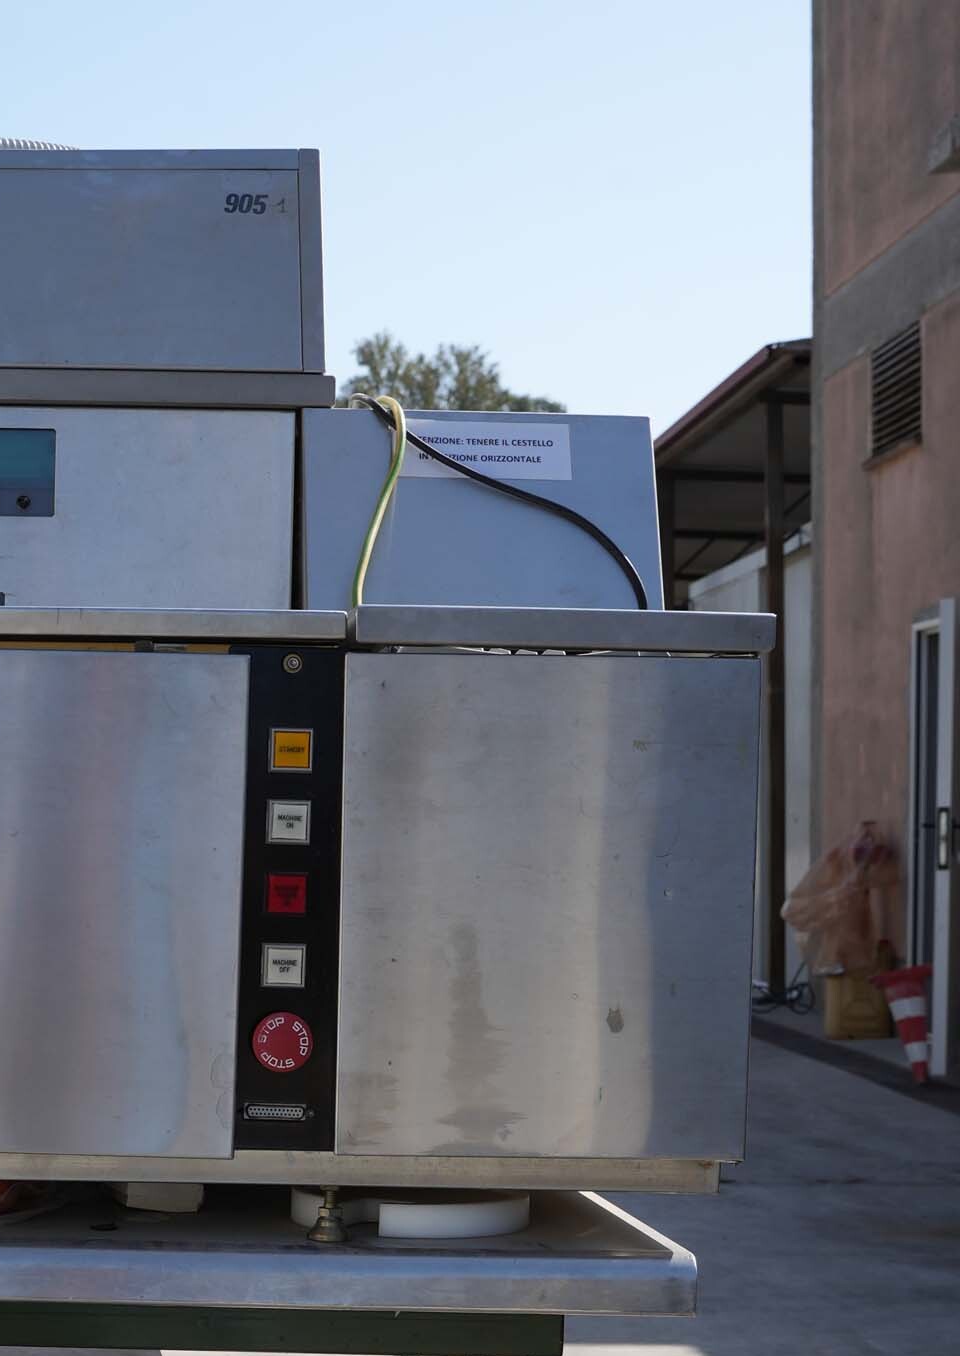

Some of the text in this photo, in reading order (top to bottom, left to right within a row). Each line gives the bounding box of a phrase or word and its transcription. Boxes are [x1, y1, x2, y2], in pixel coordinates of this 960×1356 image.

[224, 193, 268, 214] 905
[467, 438, 500, 446] TENERE
[419, 452, 429, 460] IN
[480, 454, 542, 463] ORIZZONTALE
[258, 1017, 284, 1043] STOP
[292, 1021, 309, 1056] STOP
[260, 1052, 295, 1069] STOP
